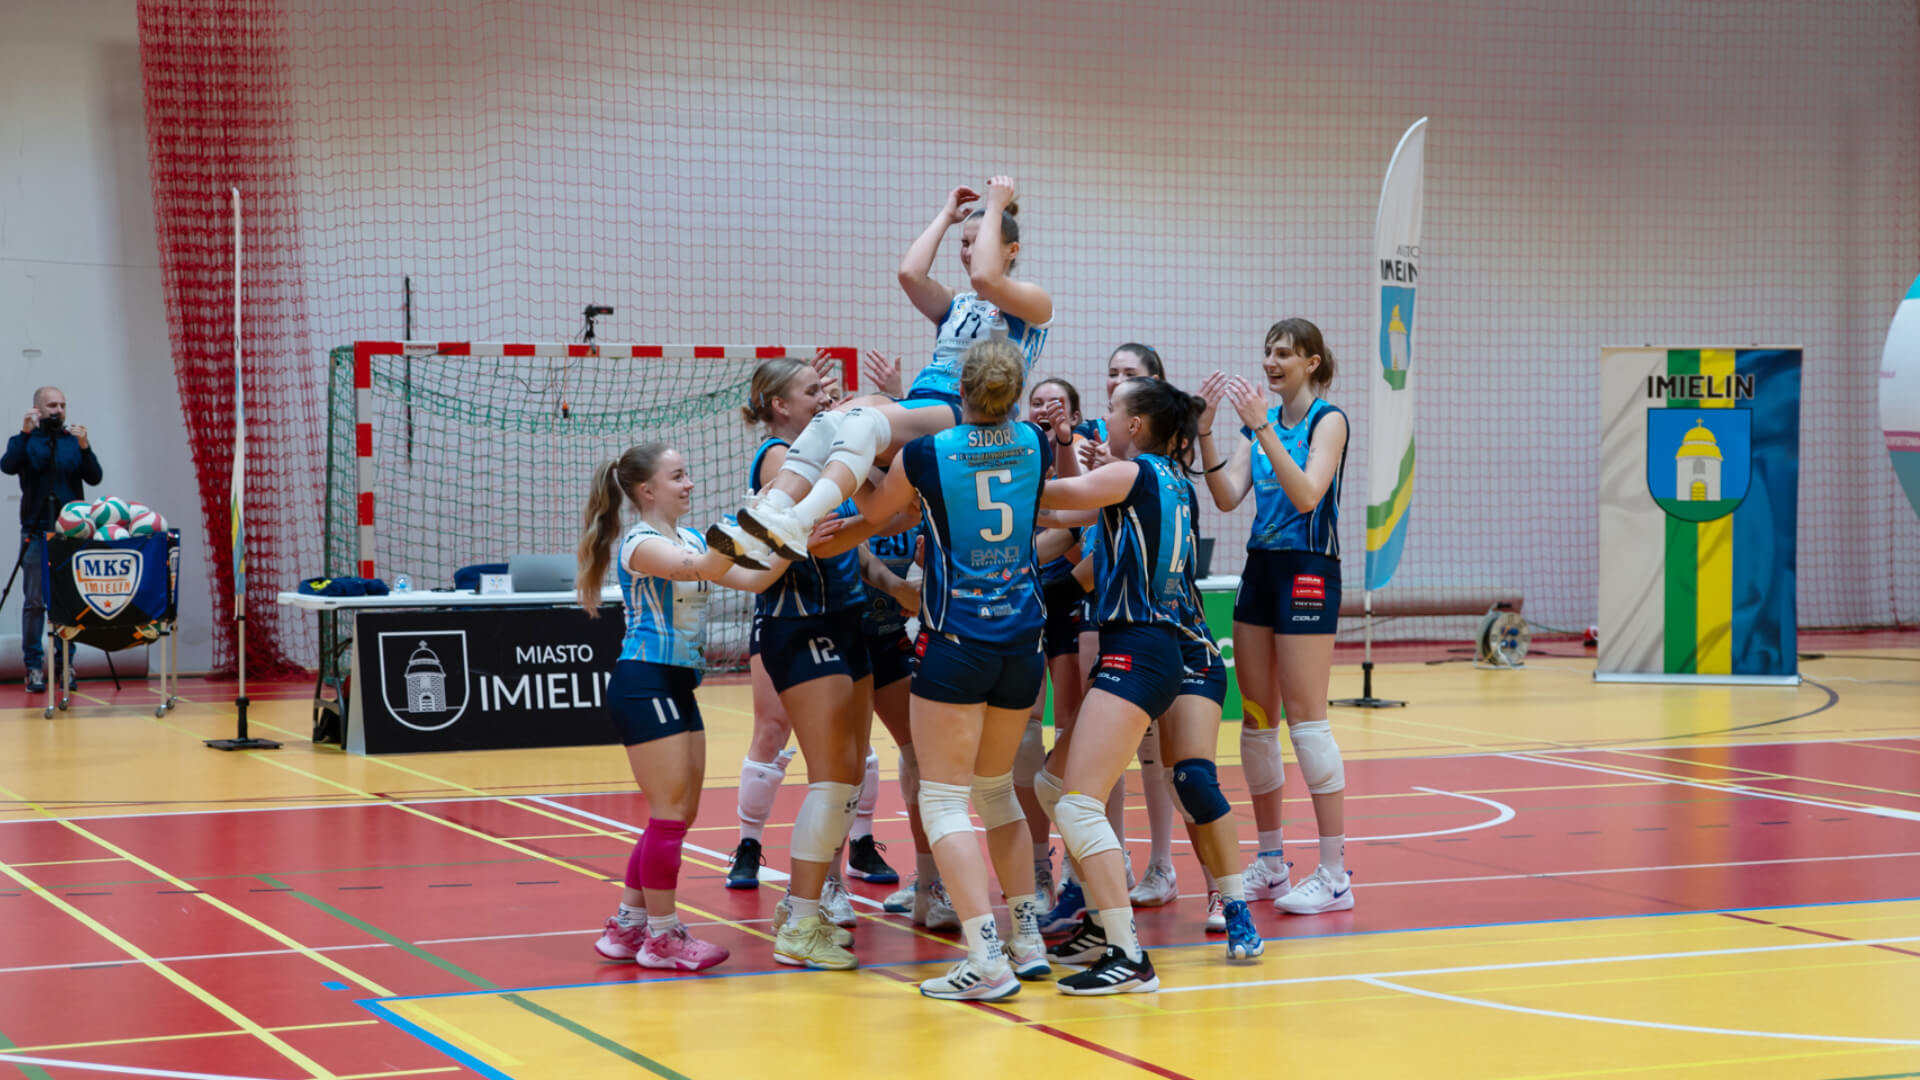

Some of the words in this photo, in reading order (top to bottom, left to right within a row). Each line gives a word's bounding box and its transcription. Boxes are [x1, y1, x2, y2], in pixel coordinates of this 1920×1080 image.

[1647, 375, 1755, 399] IMIELIN
[975, 469, 1013, 542] 5
[83, 559, 132, 577] MKS
[516, 644, 594, 664] MIASTO
[808, 636, 841, 665] 12
[651, 697, 681, 724] 11
